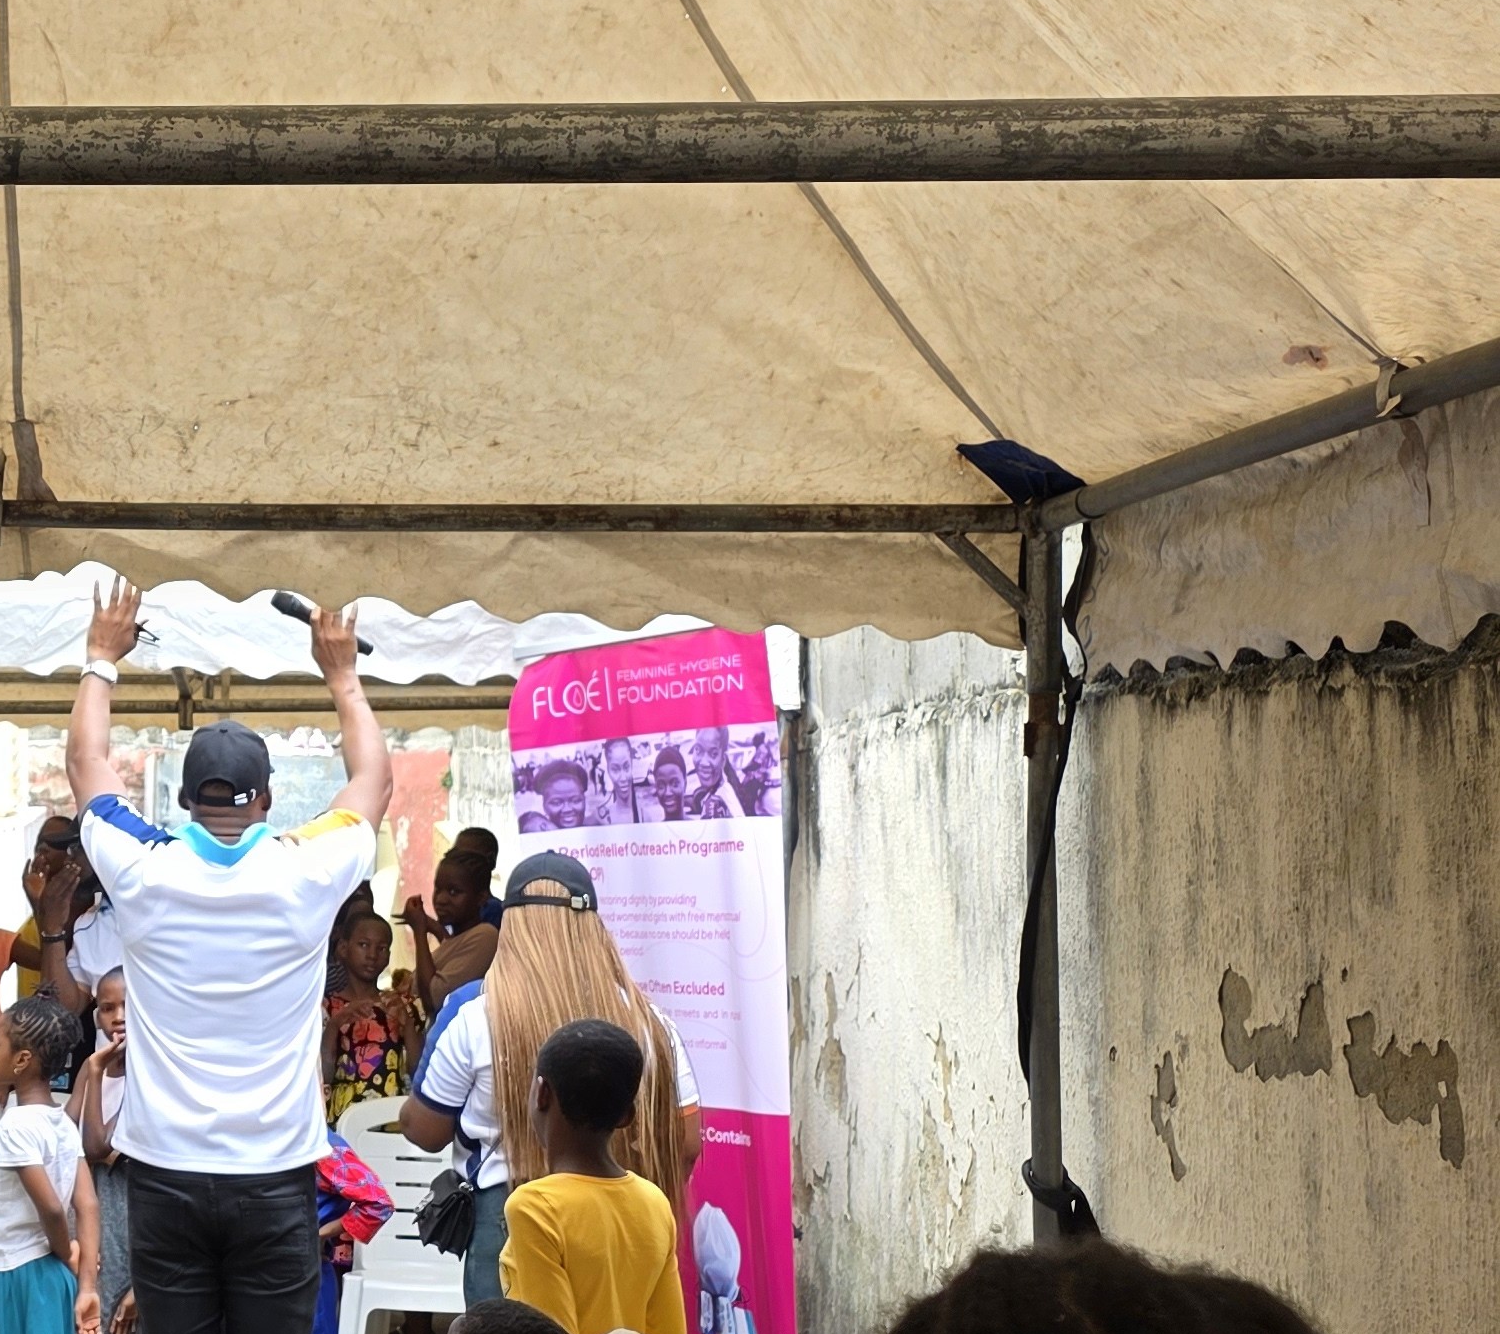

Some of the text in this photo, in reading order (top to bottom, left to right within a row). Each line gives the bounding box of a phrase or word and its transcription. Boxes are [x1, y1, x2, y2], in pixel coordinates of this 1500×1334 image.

[616, 654, 742, 682] FEMININE HYGIENE
[532, 670, 744, 721] FLOÉ FOUNDATION
[600, 842, 629, 858] Relief
[631, 839, 677, 857] Outreach
[679, 839, 745, 857] Programme
[658, 893, 697, 907] providing
[670, 911, 686, 922] with
[688, 910, 705, 923] free
[620, 929, 647, 940] because
[671, 928, 699, 940] should
[701, 928, 713, 940] be
[649, 979, 672, 994] Often
[673, 980, 725, 996] Excluded
[703, 1009, 719, 1020] and
[721, 1009, 730, 1019] in
